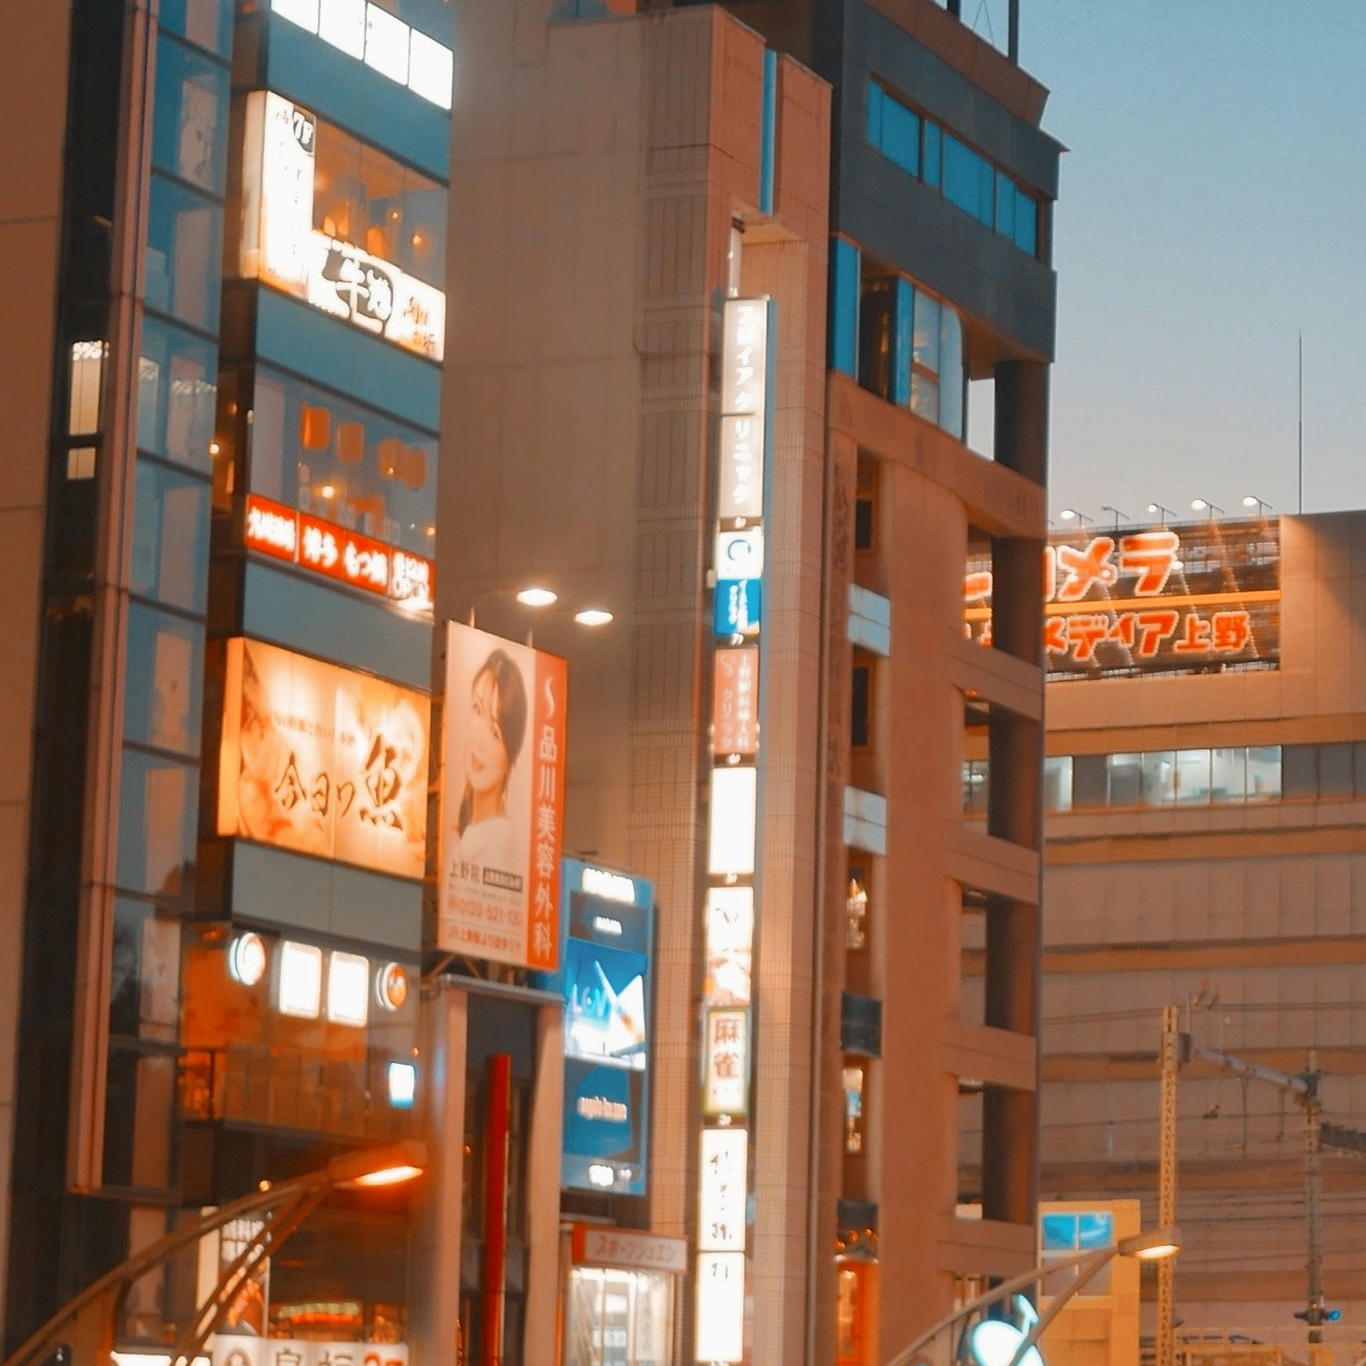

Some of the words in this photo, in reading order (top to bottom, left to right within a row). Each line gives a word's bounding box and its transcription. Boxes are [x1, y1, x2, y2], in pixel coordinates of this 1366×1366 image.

[532, 723, 558, 961] 品川美容外科
[713, 1017, 741, 1079] 麻雀
